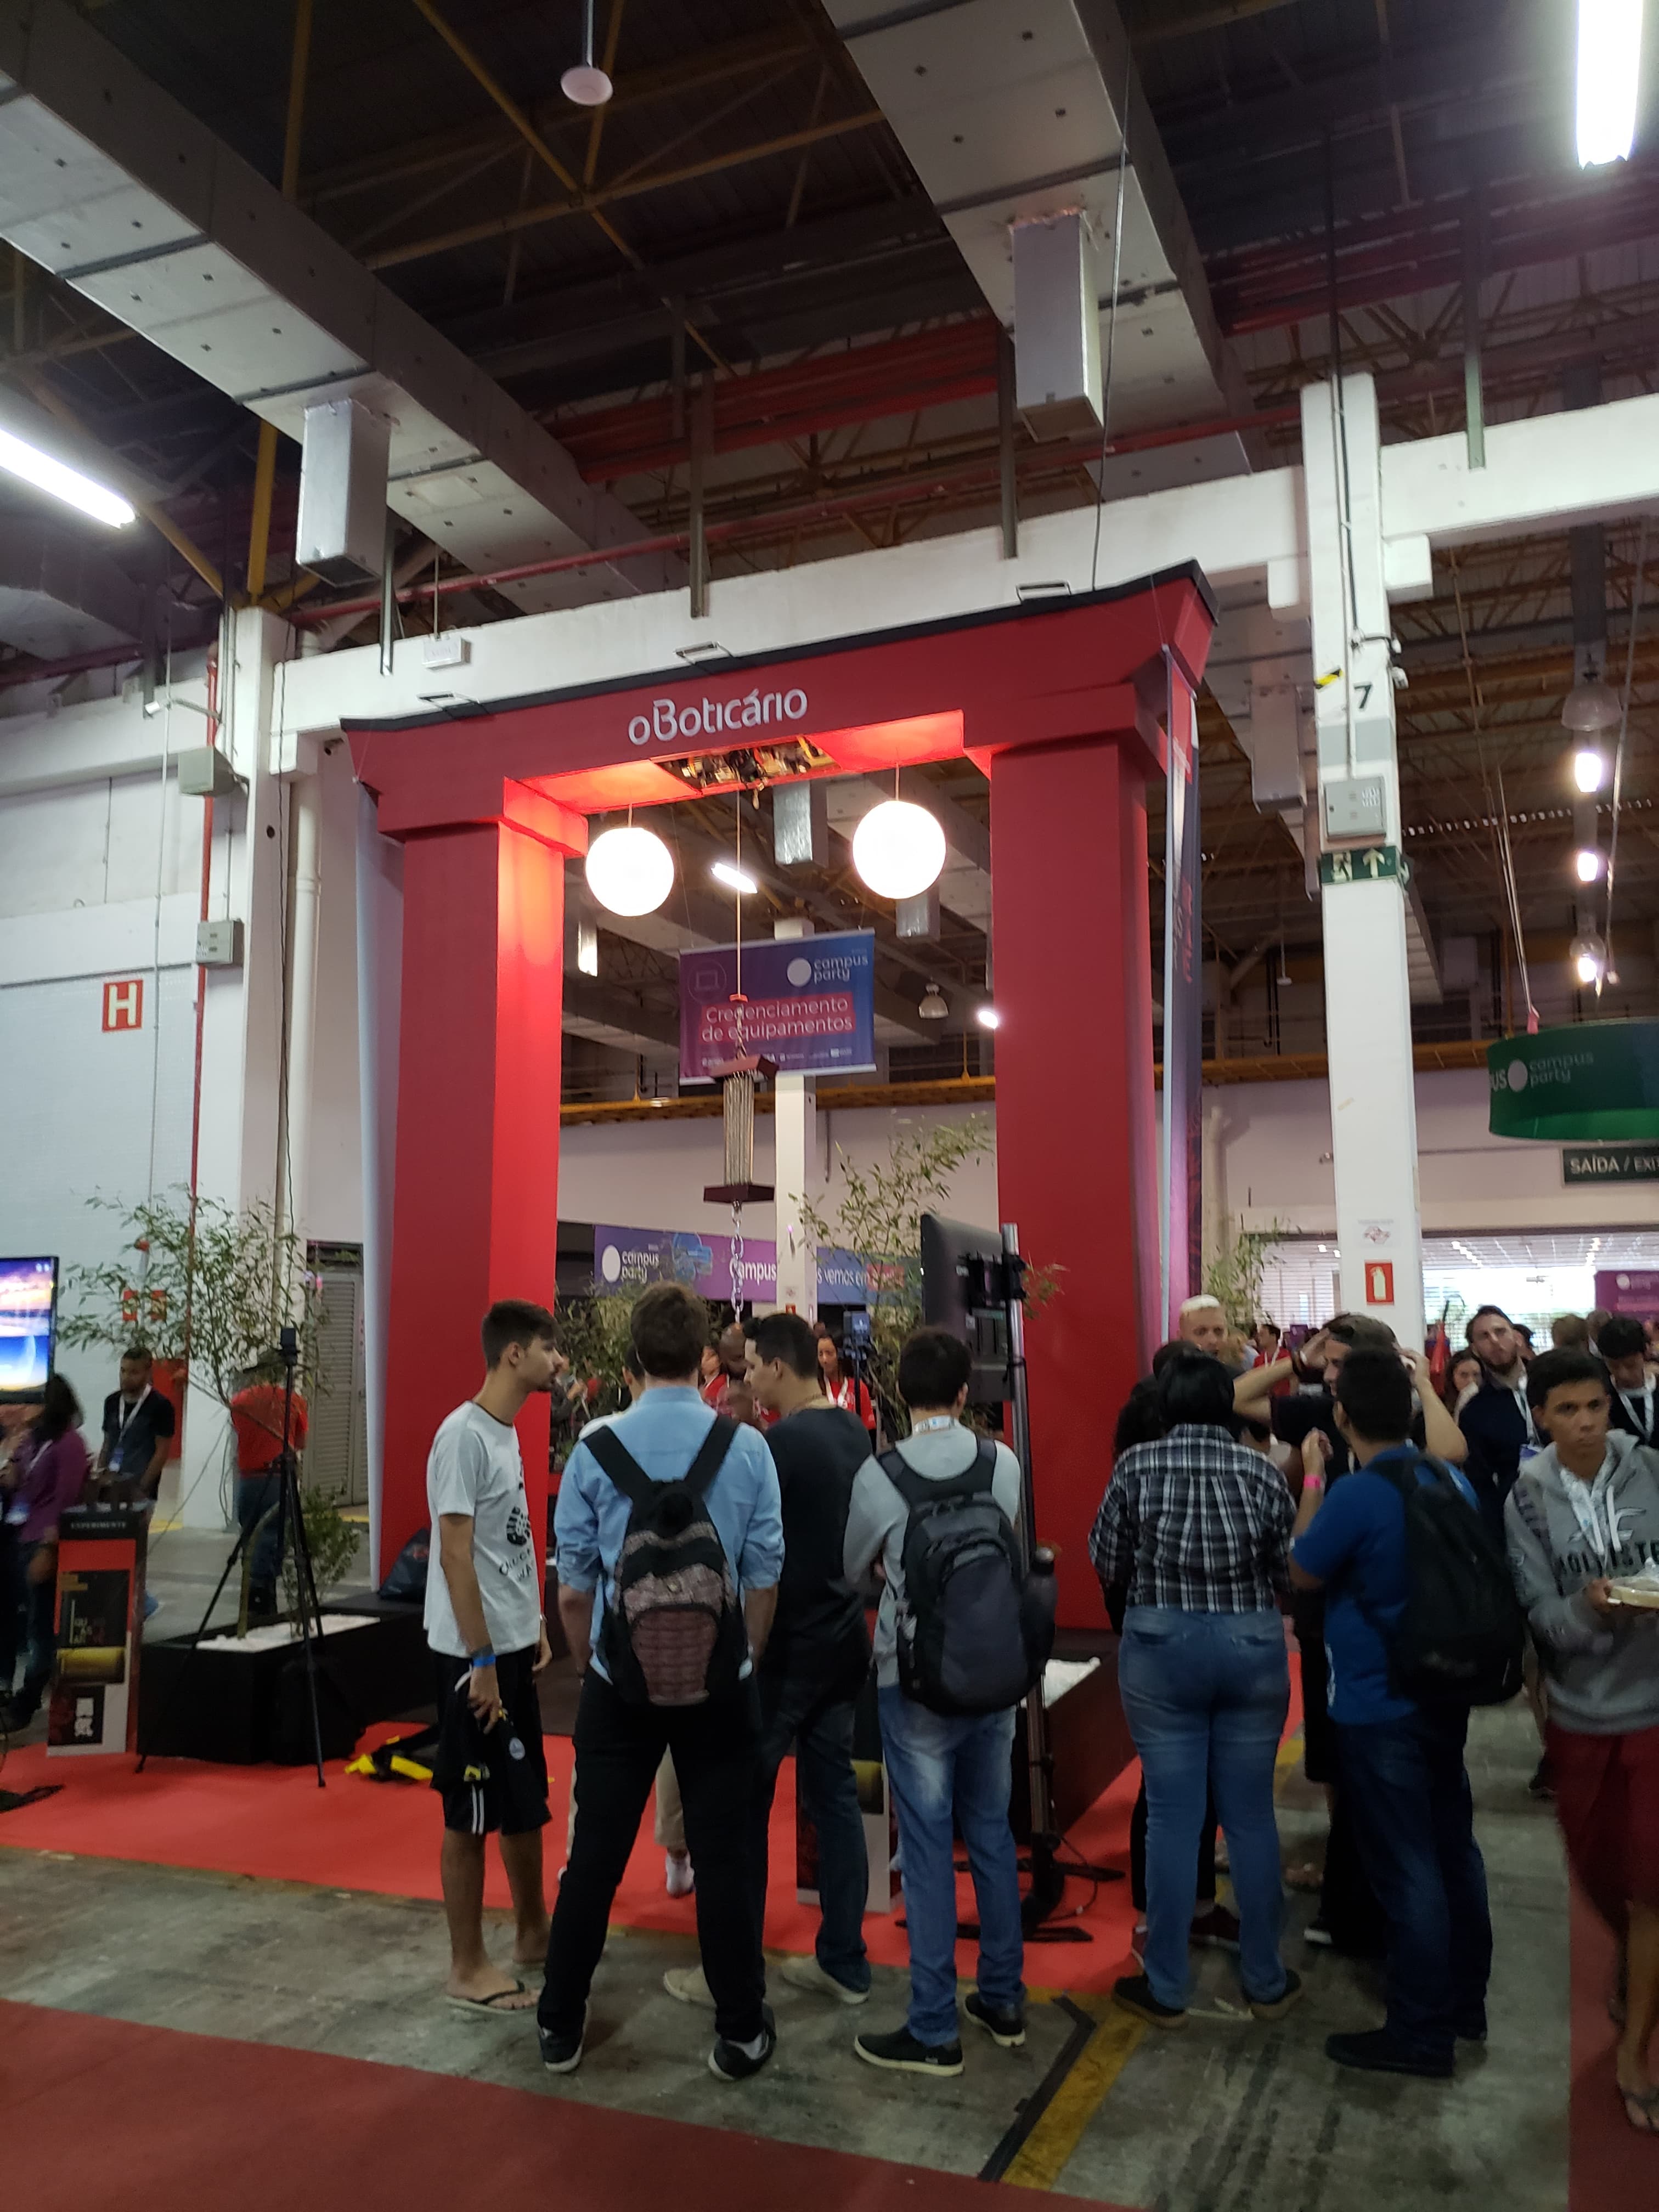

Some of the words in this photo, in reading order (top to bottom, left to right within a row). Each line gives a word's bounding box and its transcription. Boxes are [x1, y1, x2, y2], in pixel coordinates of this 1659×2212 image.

[1354, 684, 1372, 709] 7
[814, 956, 868, 970] campus
[814, 968, 850, 985] party
[108, 983, 137, 1028] H
[706, 997, 848, 1023] Credenciamento
[702, 1025, 724, 1042] de
[728, 1017, 853, 1041] equipamentos
[622, 1250, 660, 1269] campus
[621, 1267, 648, 1284] party
